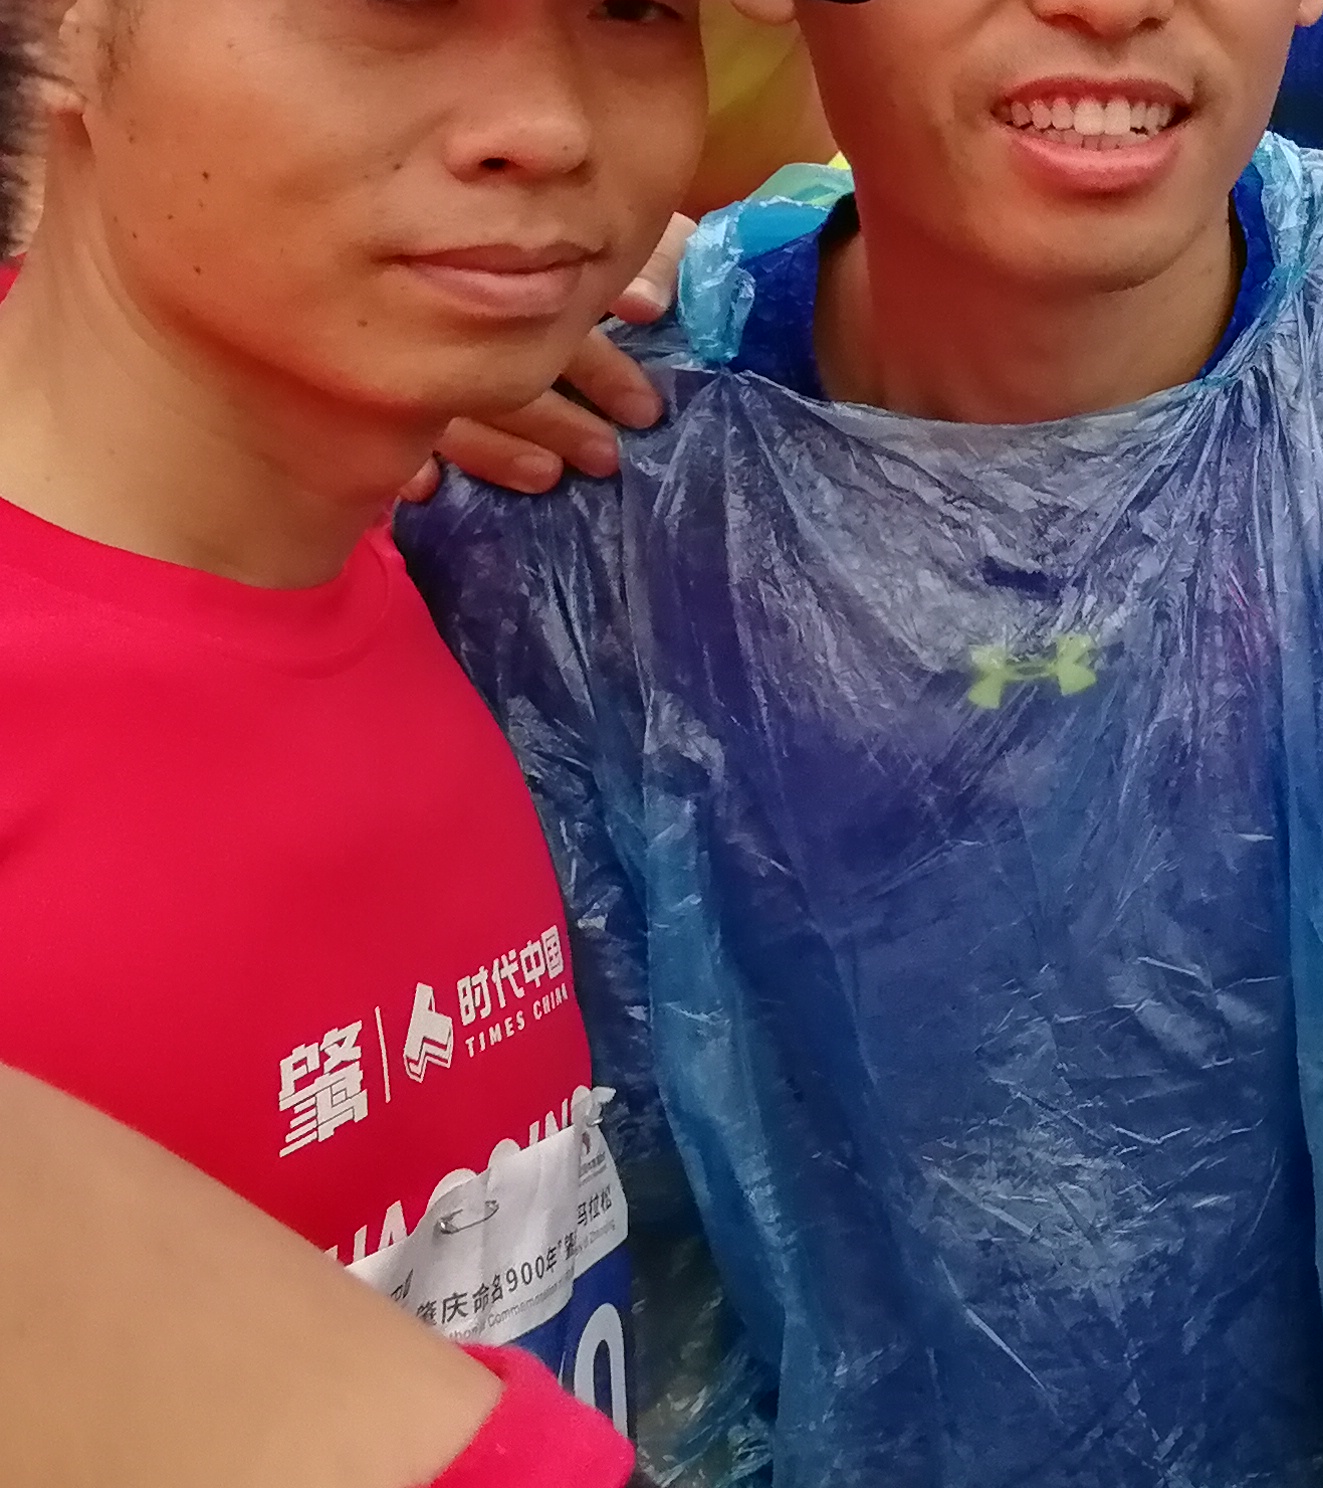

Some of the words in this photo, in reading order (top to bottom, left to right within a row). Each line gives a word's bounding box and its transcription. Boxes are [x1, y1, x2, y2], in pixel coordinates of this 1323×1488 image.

[457, 924, 564, 1026] 时代中国
[465, 1010, 525, 1058] TIMES
